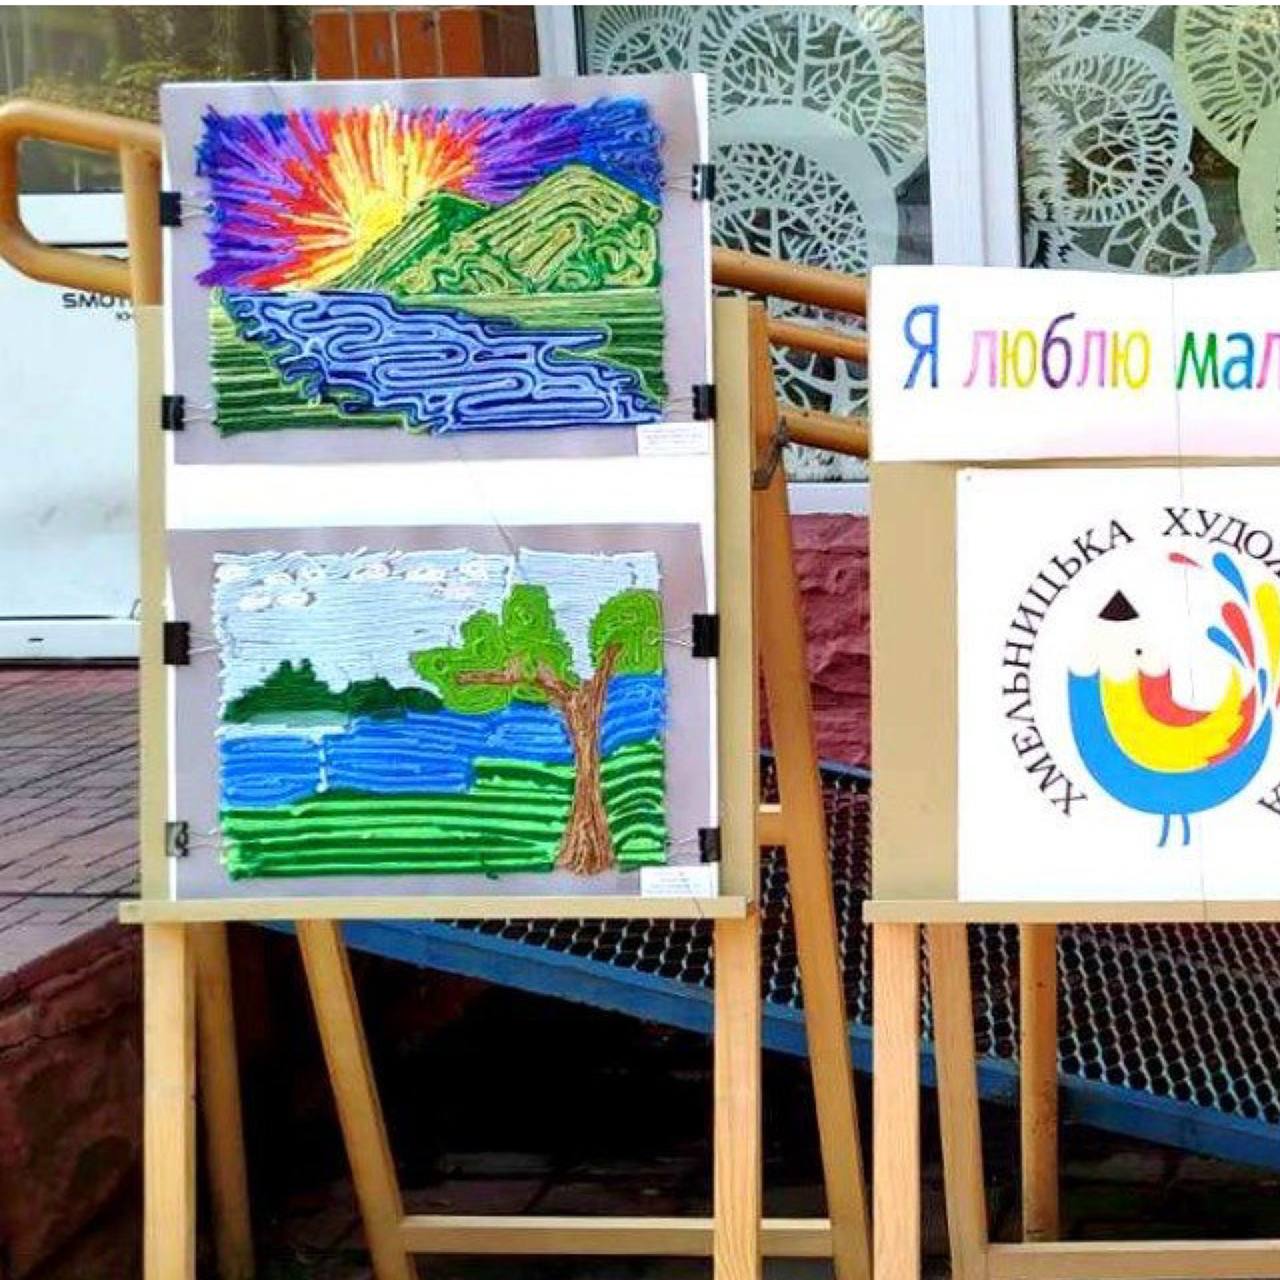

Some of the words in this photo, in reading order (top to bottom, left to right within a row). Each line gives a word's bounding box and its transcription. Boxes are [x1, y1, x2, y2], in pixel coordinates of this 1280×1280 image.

[62, 291, 135, 308] SMOT
[903, 303, 940, 390] Я
[963, 312, 1152, 392] люблю
[1002, 519, 1135, 817] ХМЕЛЬНИЦЬКА
